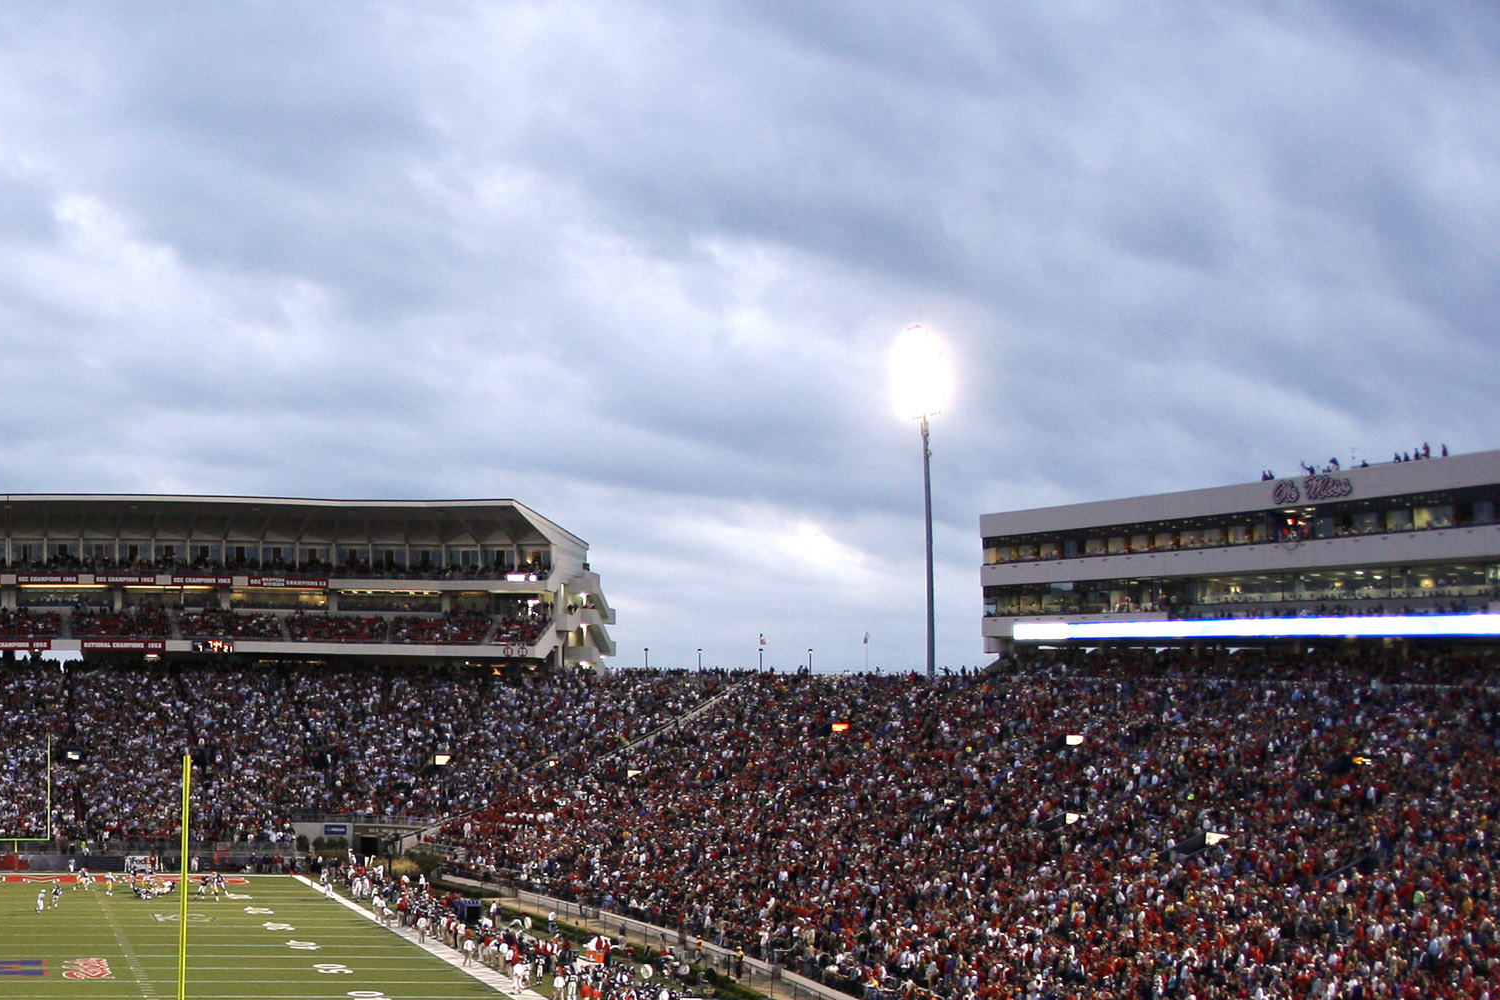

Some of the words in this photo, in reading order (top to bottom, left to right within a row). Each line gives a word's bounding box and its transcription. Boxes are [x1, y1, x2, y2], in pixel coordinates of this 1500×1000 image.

[1272, 480, 1300, 504] Ole
[1304, 474, 1352, 500] Miss
[313, 963, 354, 975] 50
